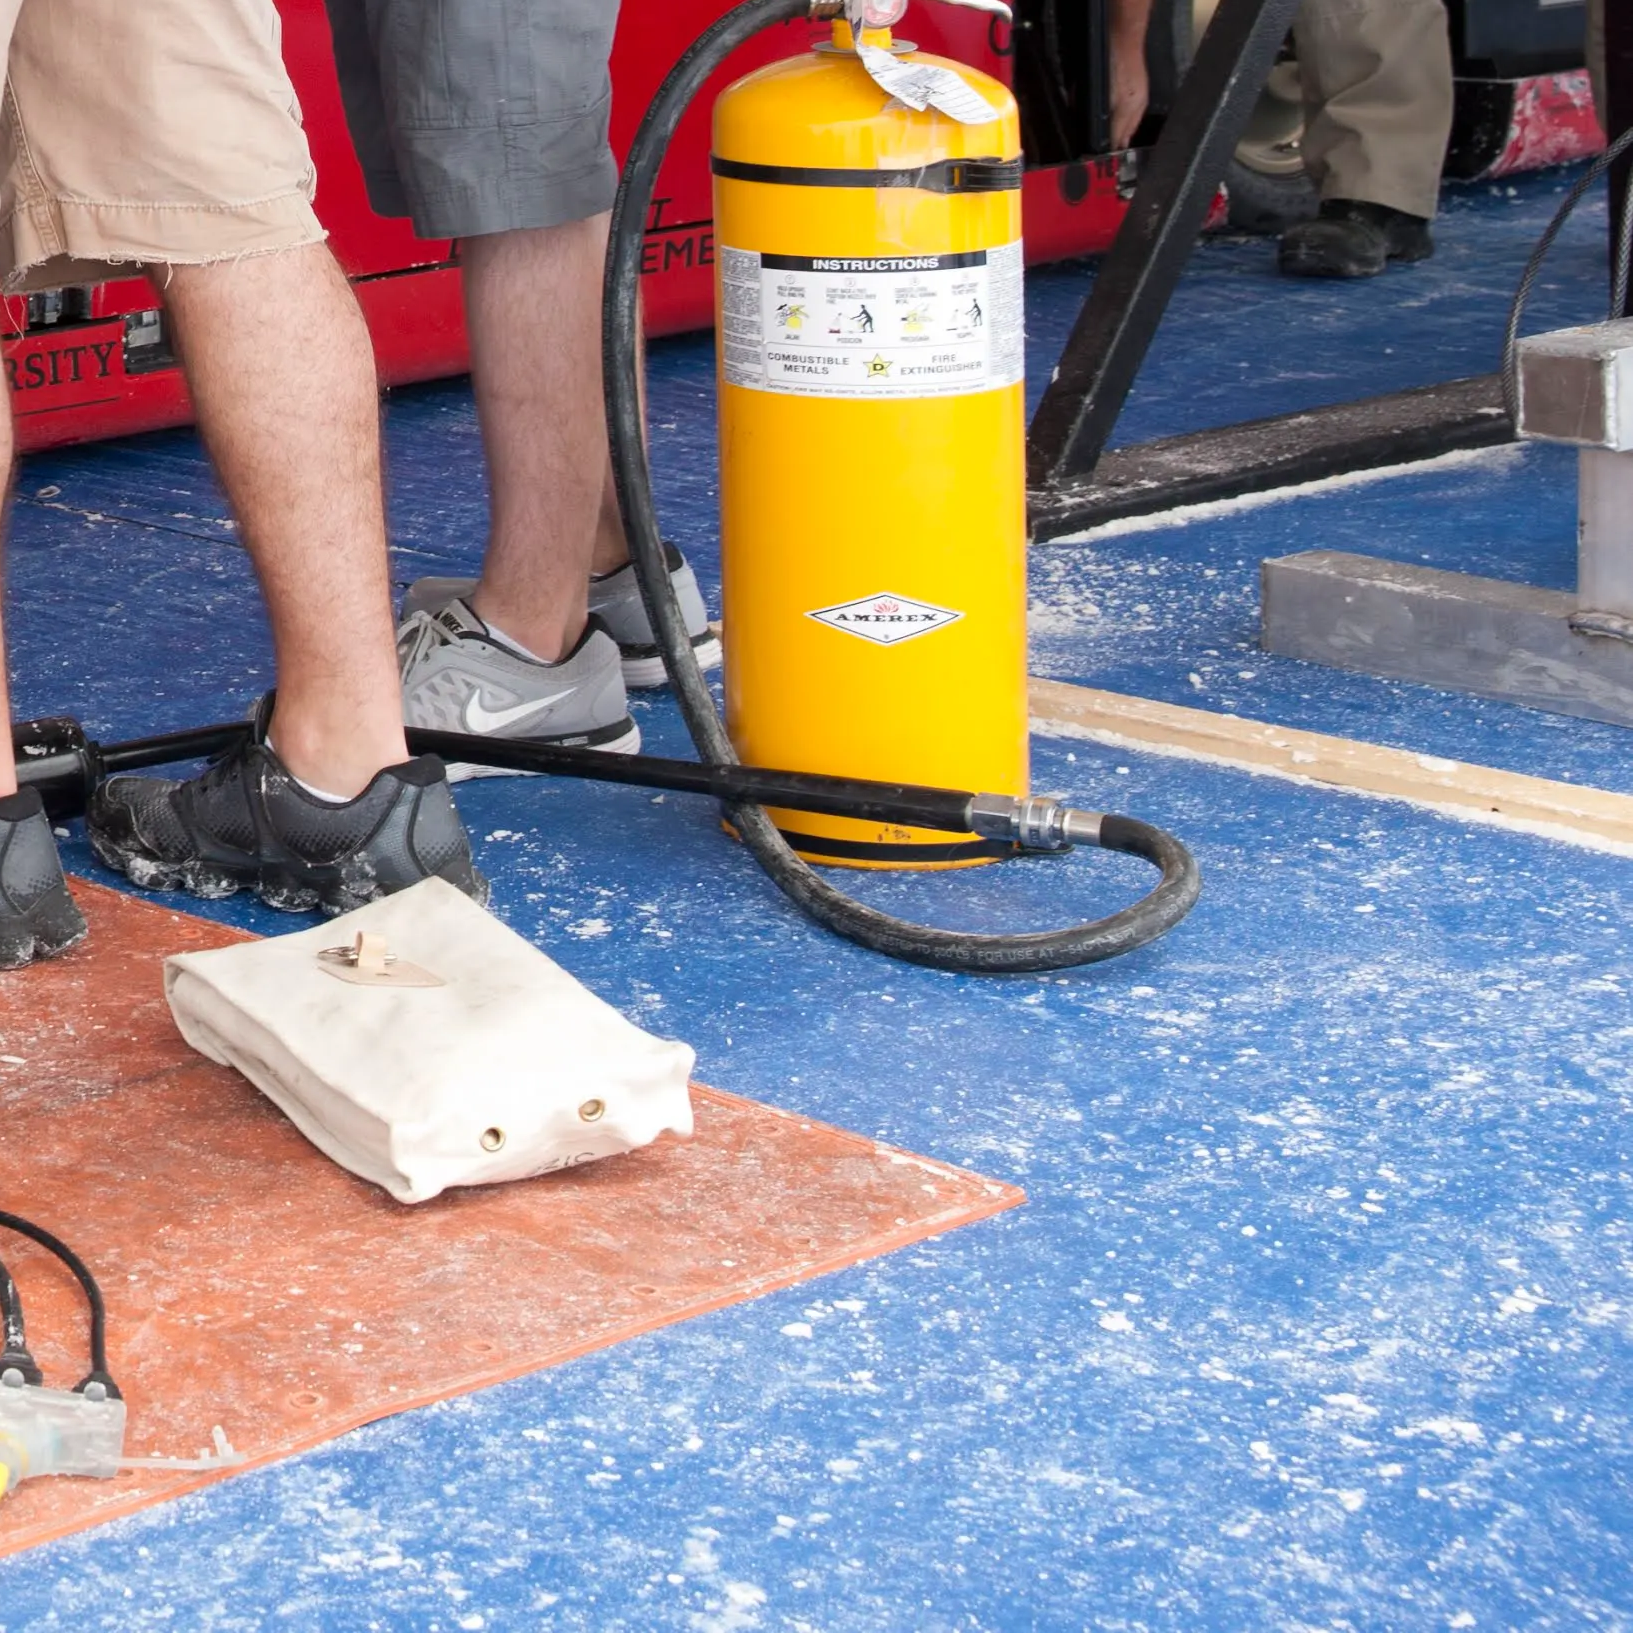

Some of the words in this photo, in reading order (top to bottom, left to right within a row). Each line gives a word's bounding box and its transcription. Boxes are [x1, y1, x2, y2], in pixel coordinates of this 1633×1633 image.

[812, 257, 939, 271] INSTRUCTIONS
[767, 351, 849, 366] COMBUSTIBLE
[932, 354, 956, 363] FIRE
[783, 363, 830, 376] METALS
[873, 363, 884, 372] D
[900, 360, 983, 376] EXTINGUISHER
[834, 612, 939, 623] AMEREX
